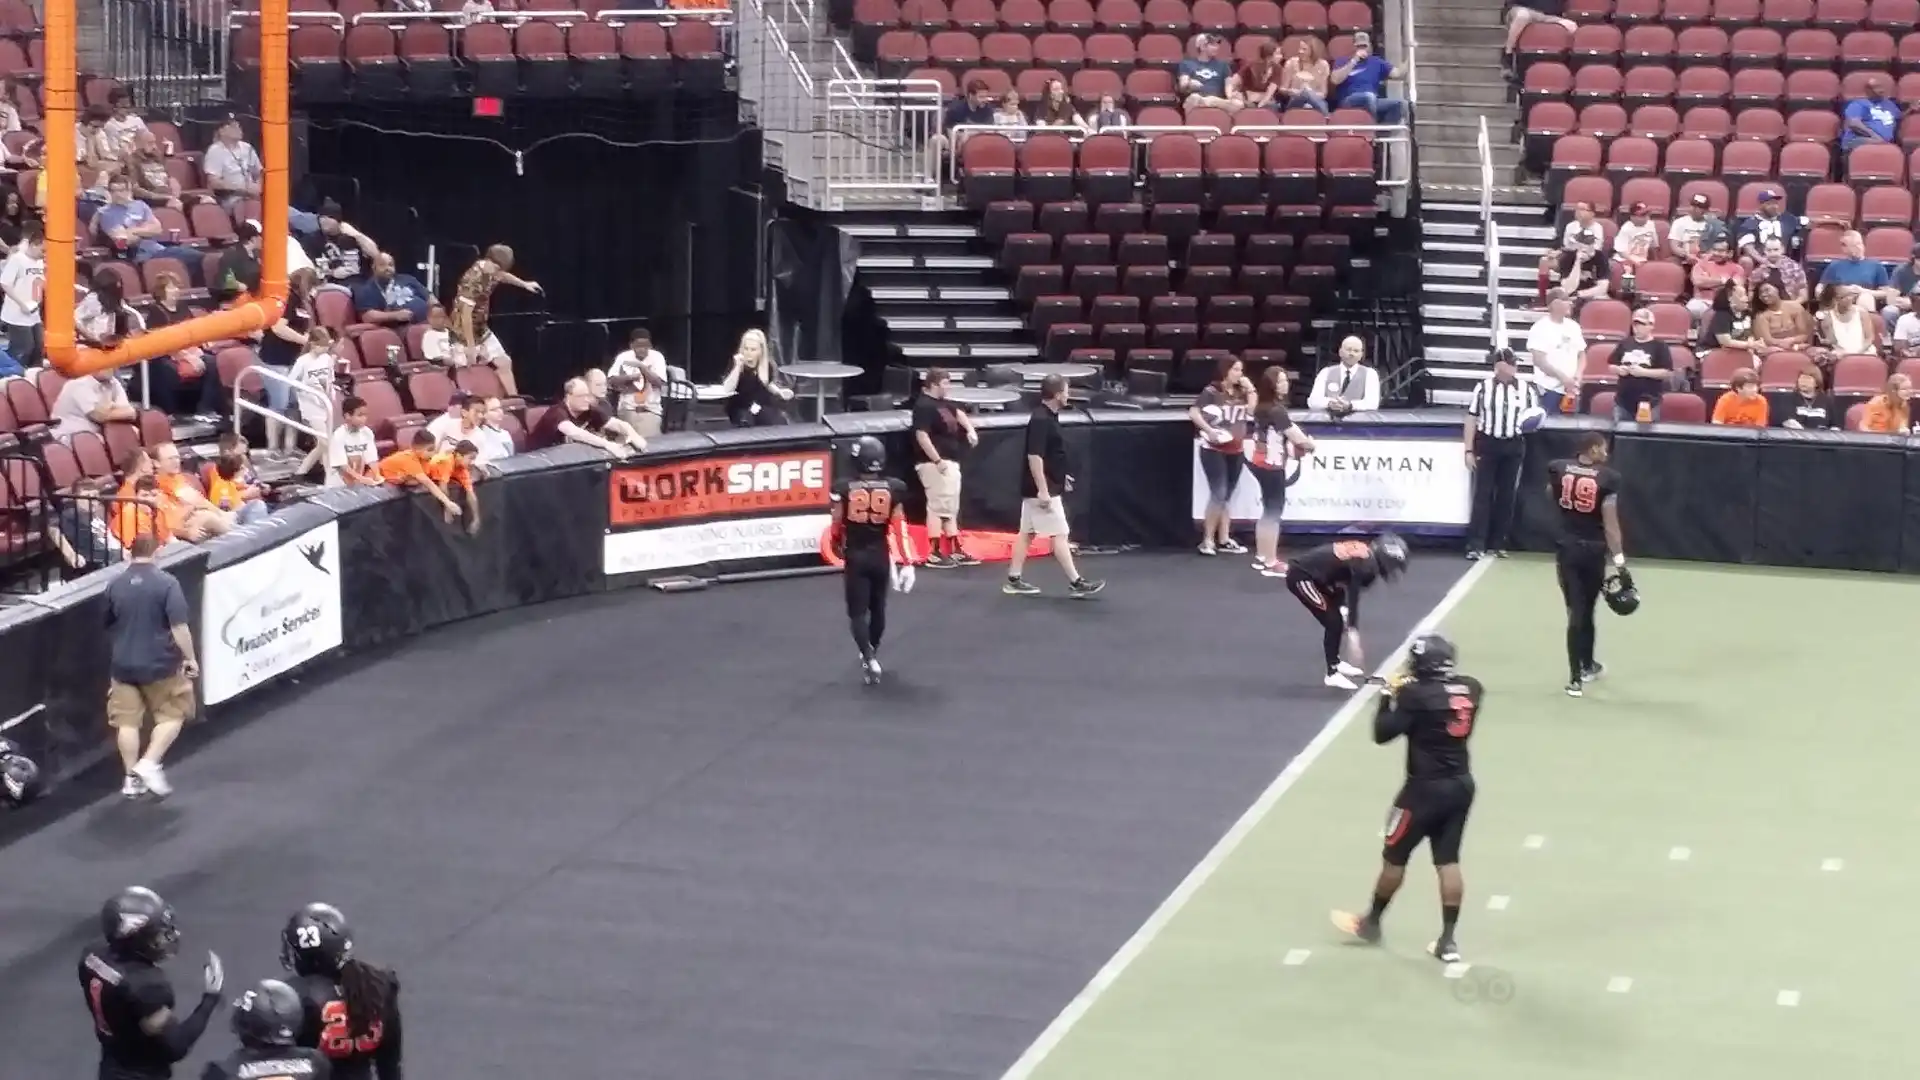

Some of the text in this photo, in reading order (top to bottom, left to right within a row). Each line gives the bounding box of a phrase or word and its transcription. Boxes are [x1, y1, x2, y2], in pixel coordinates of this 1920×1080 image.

[1312, 455, 1434, 472] NEWMAN
[730, 491, 821, 508] THERAPY
[1558, 473, 1598, 513] 19
[847, 488, 892, 525] 29
[295, 924, 322, 950] 23
